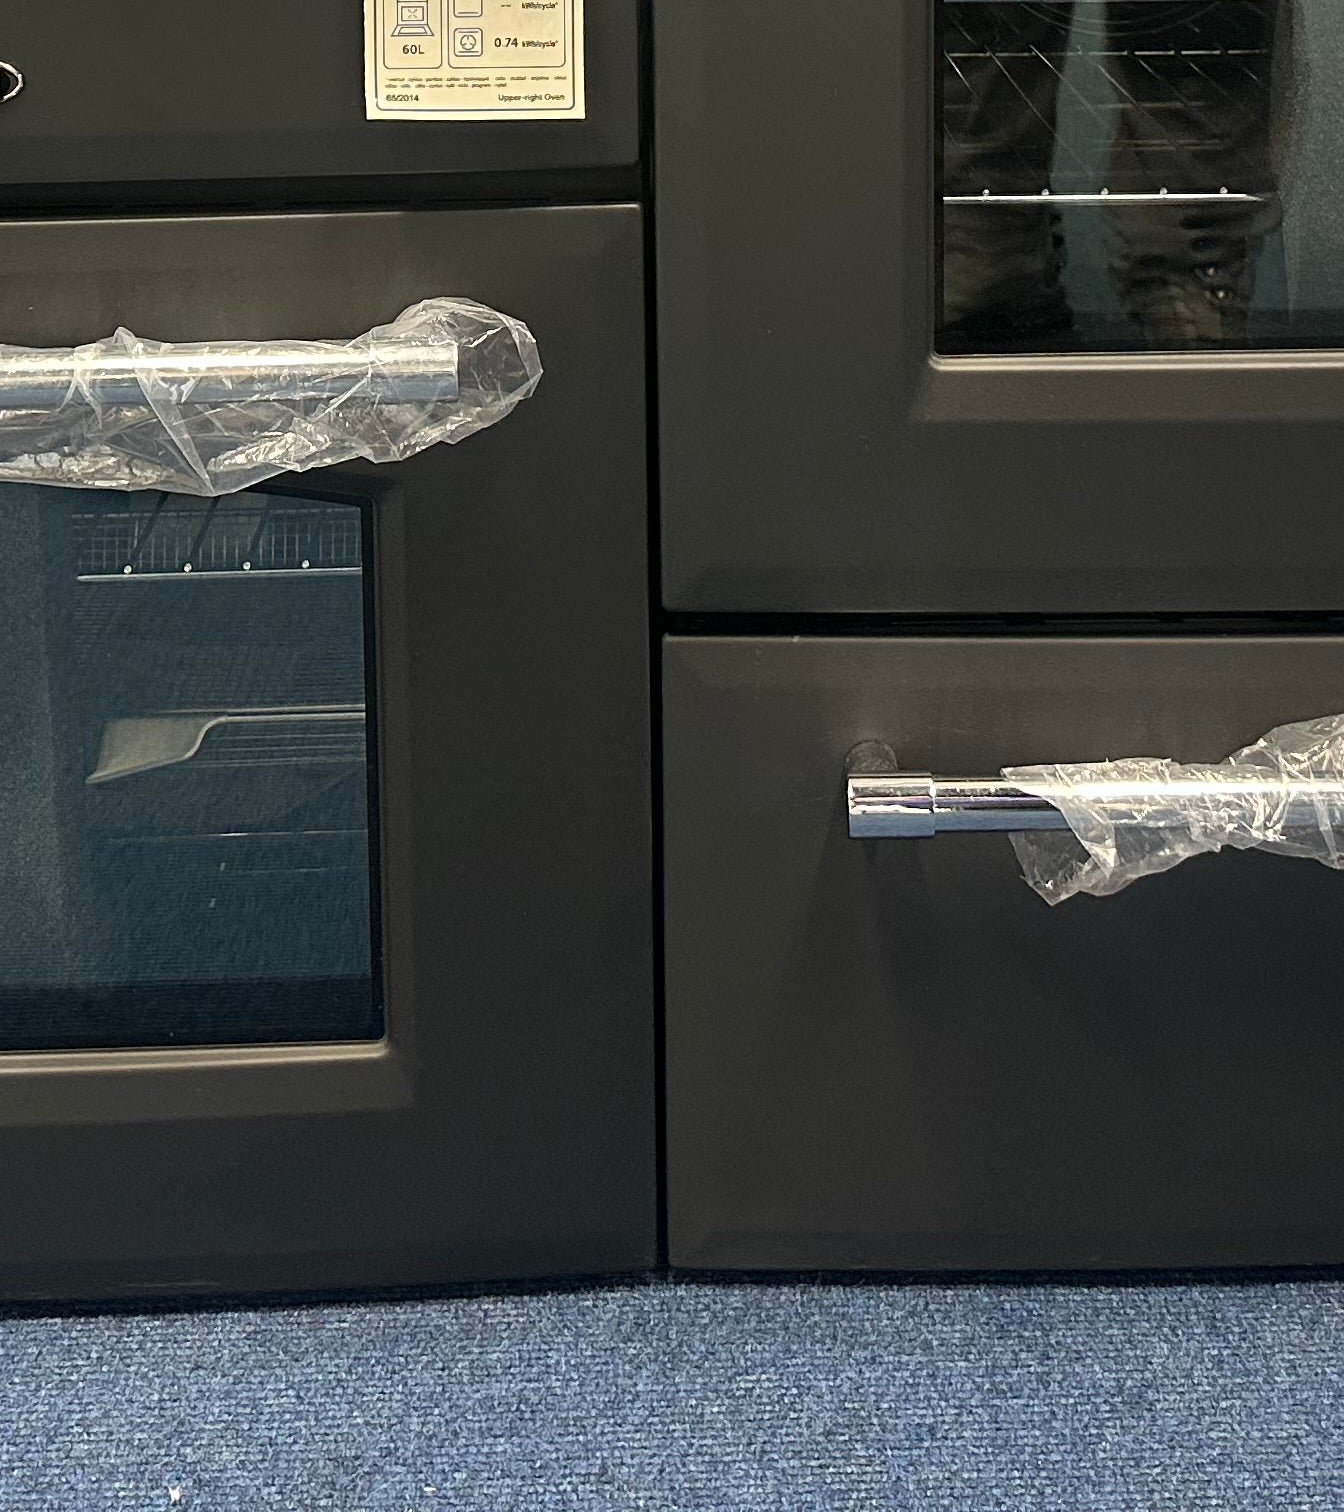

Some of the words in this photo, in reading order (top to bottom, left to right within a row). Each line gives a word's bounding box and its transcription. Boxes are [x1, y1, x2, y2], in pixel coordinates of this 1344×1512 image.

[494, 37, 519, 48] 0.74
[402, 44, 425, 55] 60L
[498, 94, 543, 103] Upper-right
[544, 93, 565, 101] Oven
